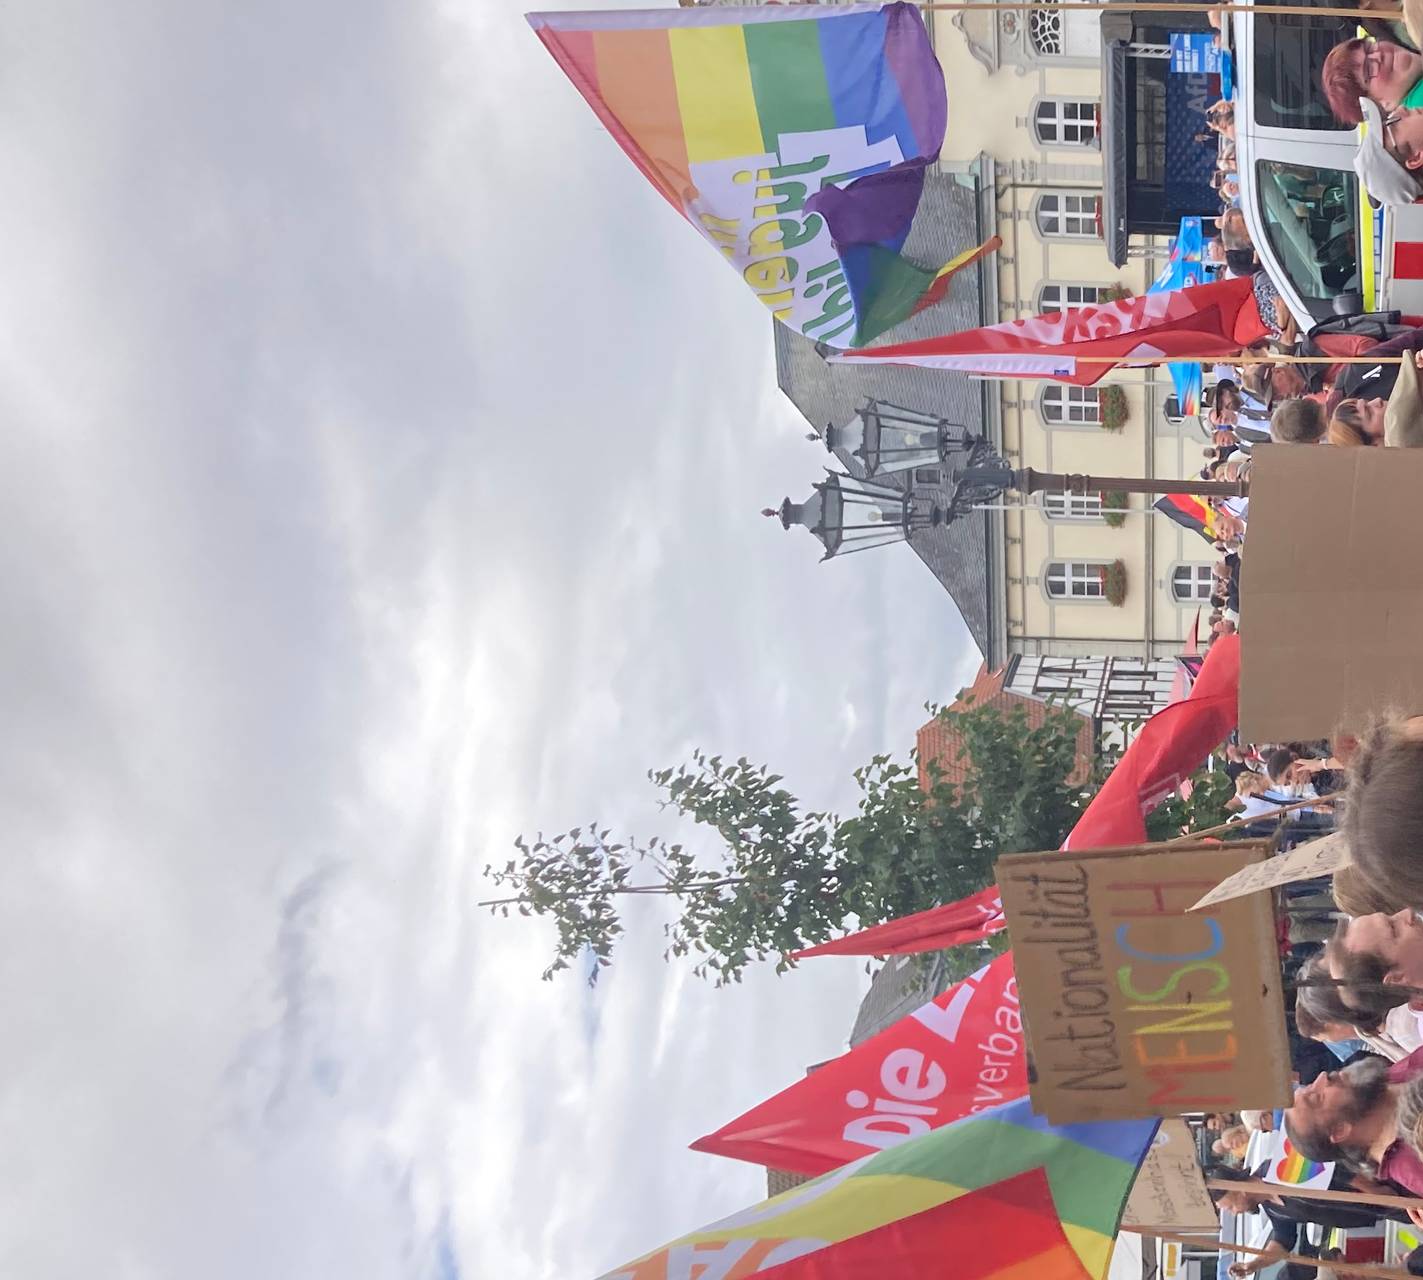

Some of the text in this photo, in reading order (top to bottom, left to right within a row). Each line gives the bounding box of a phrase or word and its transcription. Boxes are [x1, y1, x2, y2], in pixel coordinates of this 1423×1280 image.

[1007, 863, 1127, 1091] Nationalität
[1105, 879, 1238, 1107] MENSCH
[842, 1047, 947, 1150] Die
